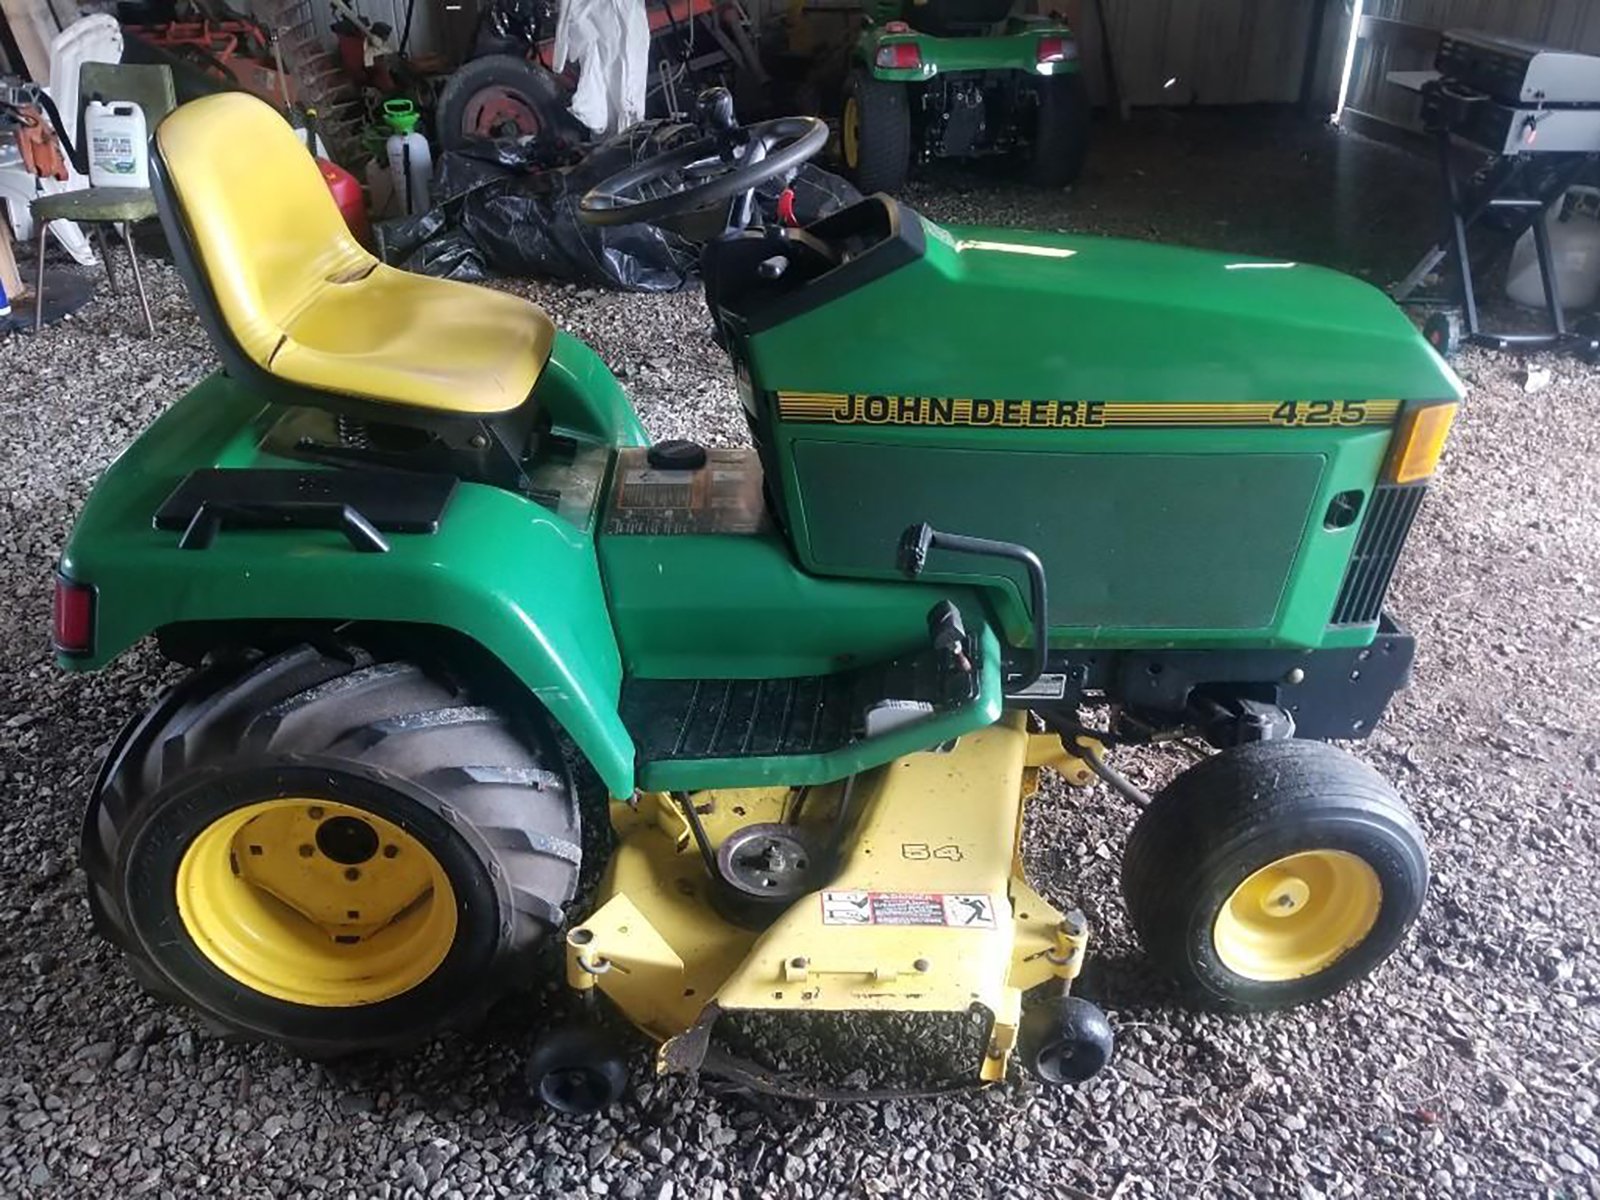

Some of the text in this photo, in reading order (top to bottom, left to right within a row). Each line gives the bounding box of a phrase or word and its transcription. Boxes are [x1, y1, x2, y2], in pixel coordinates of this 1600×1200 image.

[832, 394, 1105, 427] JOHN DEERE
[1271, 399, 1367, 426] 425
[902, 843, 964, 862] 54
